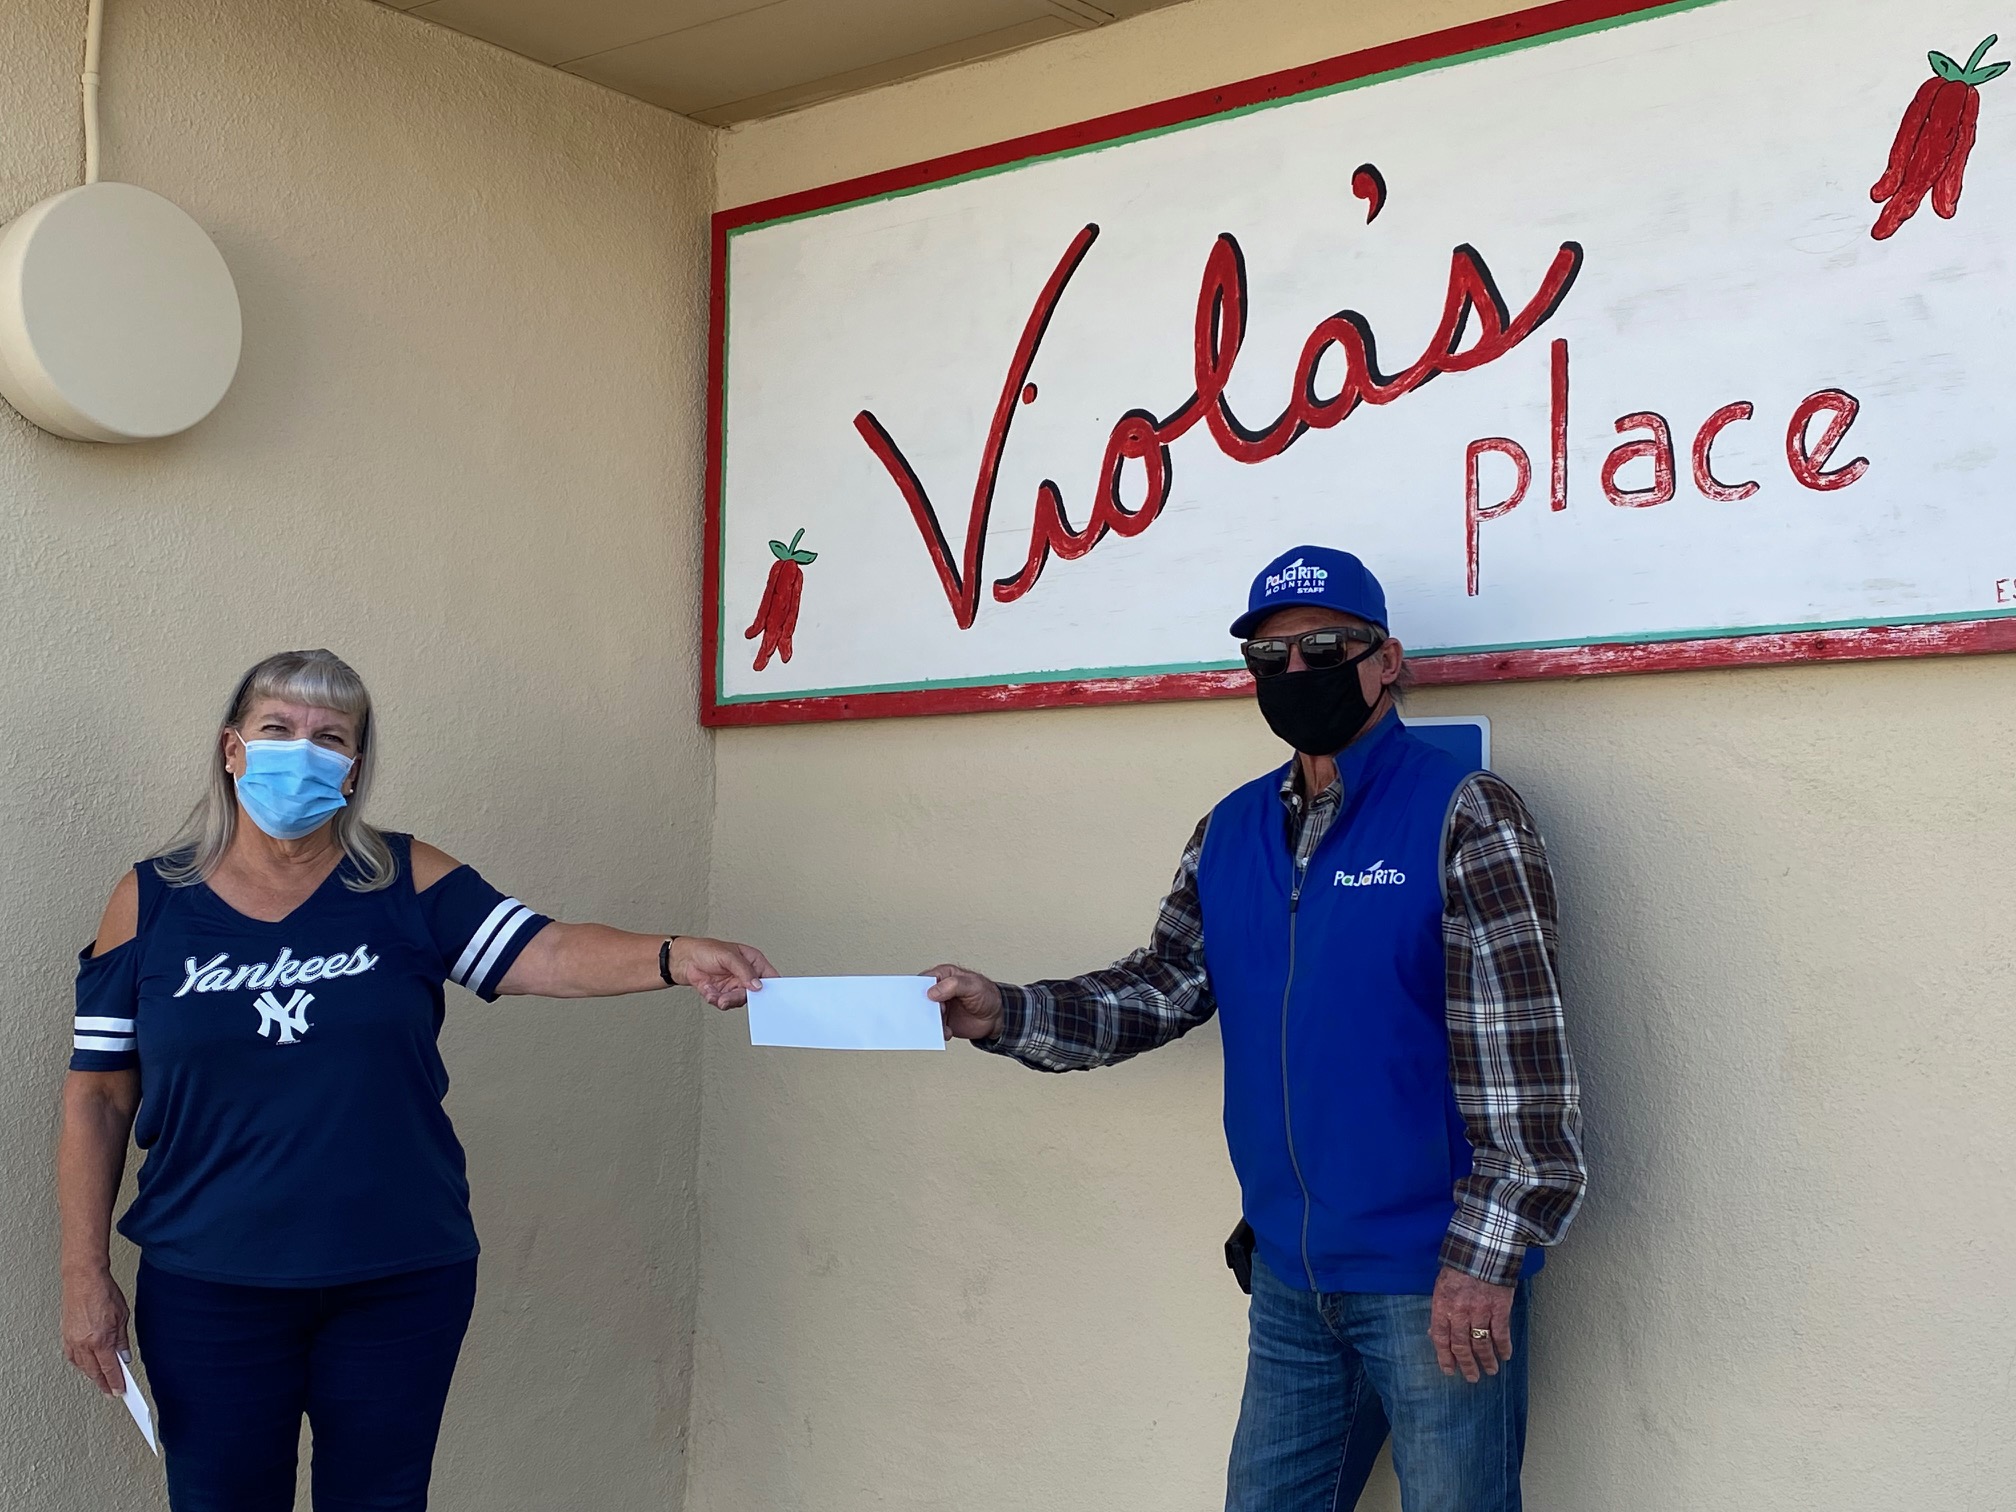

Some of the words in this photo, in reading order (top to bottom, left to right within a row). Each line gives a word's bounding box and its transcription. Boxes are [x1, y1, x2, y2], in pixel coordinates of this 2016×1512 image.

[853, 163, 1583, 629] Viola's
[1466, 338, 1870, 596] place
[1265, 580, 1325, 597] MOUNTAIN
[173, 944, 379, 997] Yankees
